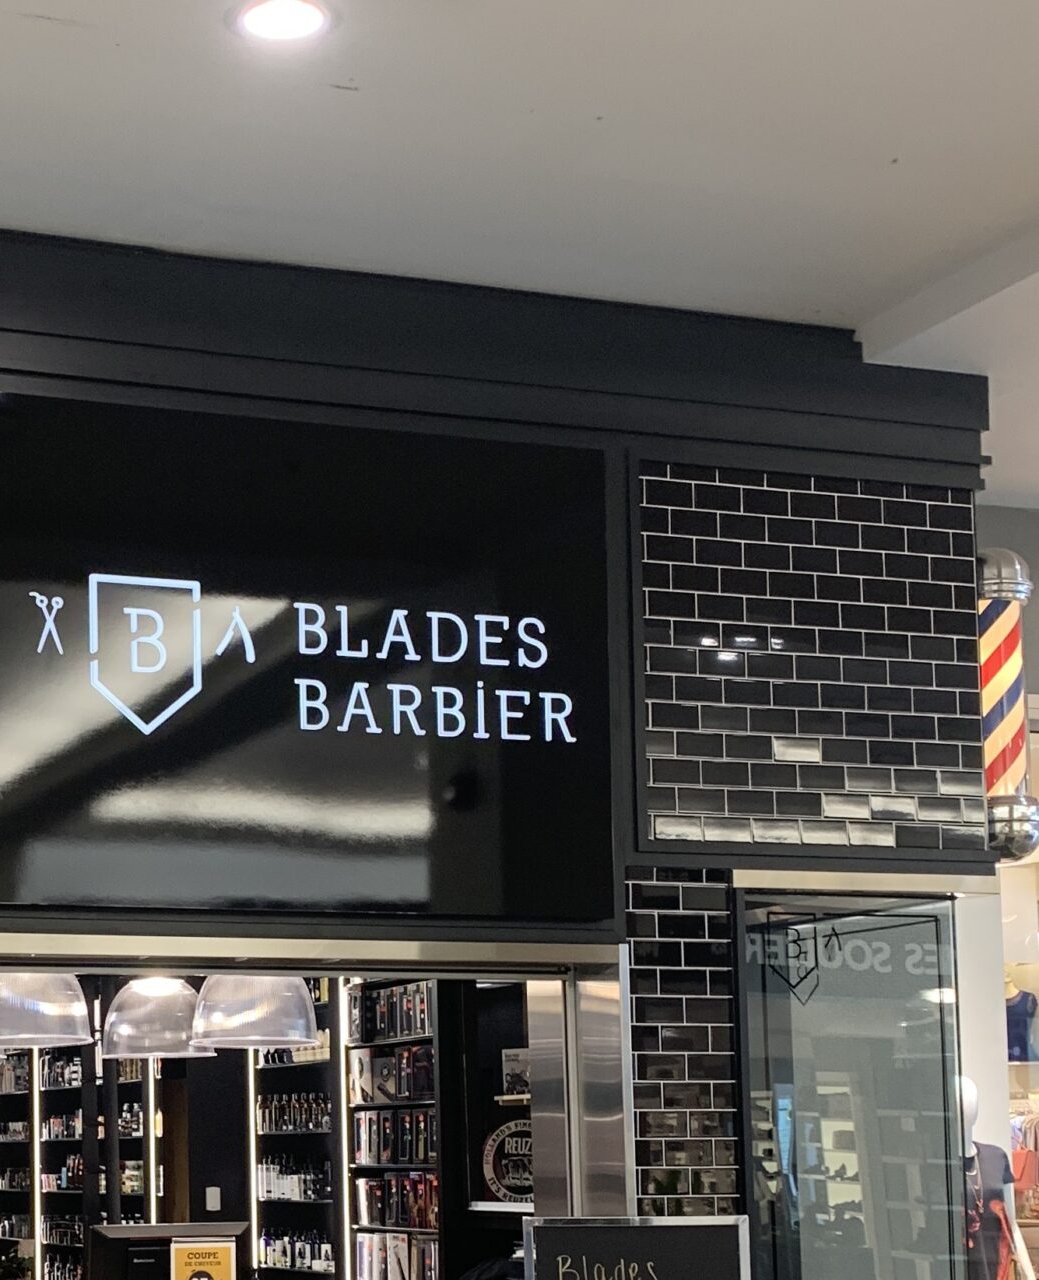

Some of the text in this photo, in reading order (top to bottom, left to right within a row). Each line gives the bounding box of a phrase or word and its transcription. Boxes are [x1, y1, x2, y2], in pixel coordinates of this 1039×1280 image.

[123, 607, 167, 673] B
[293, 601, 549, 668] BLADES
[504, 1137, 532, 1155] REUZ
[187, 1251, 219, 1260] COUPE
